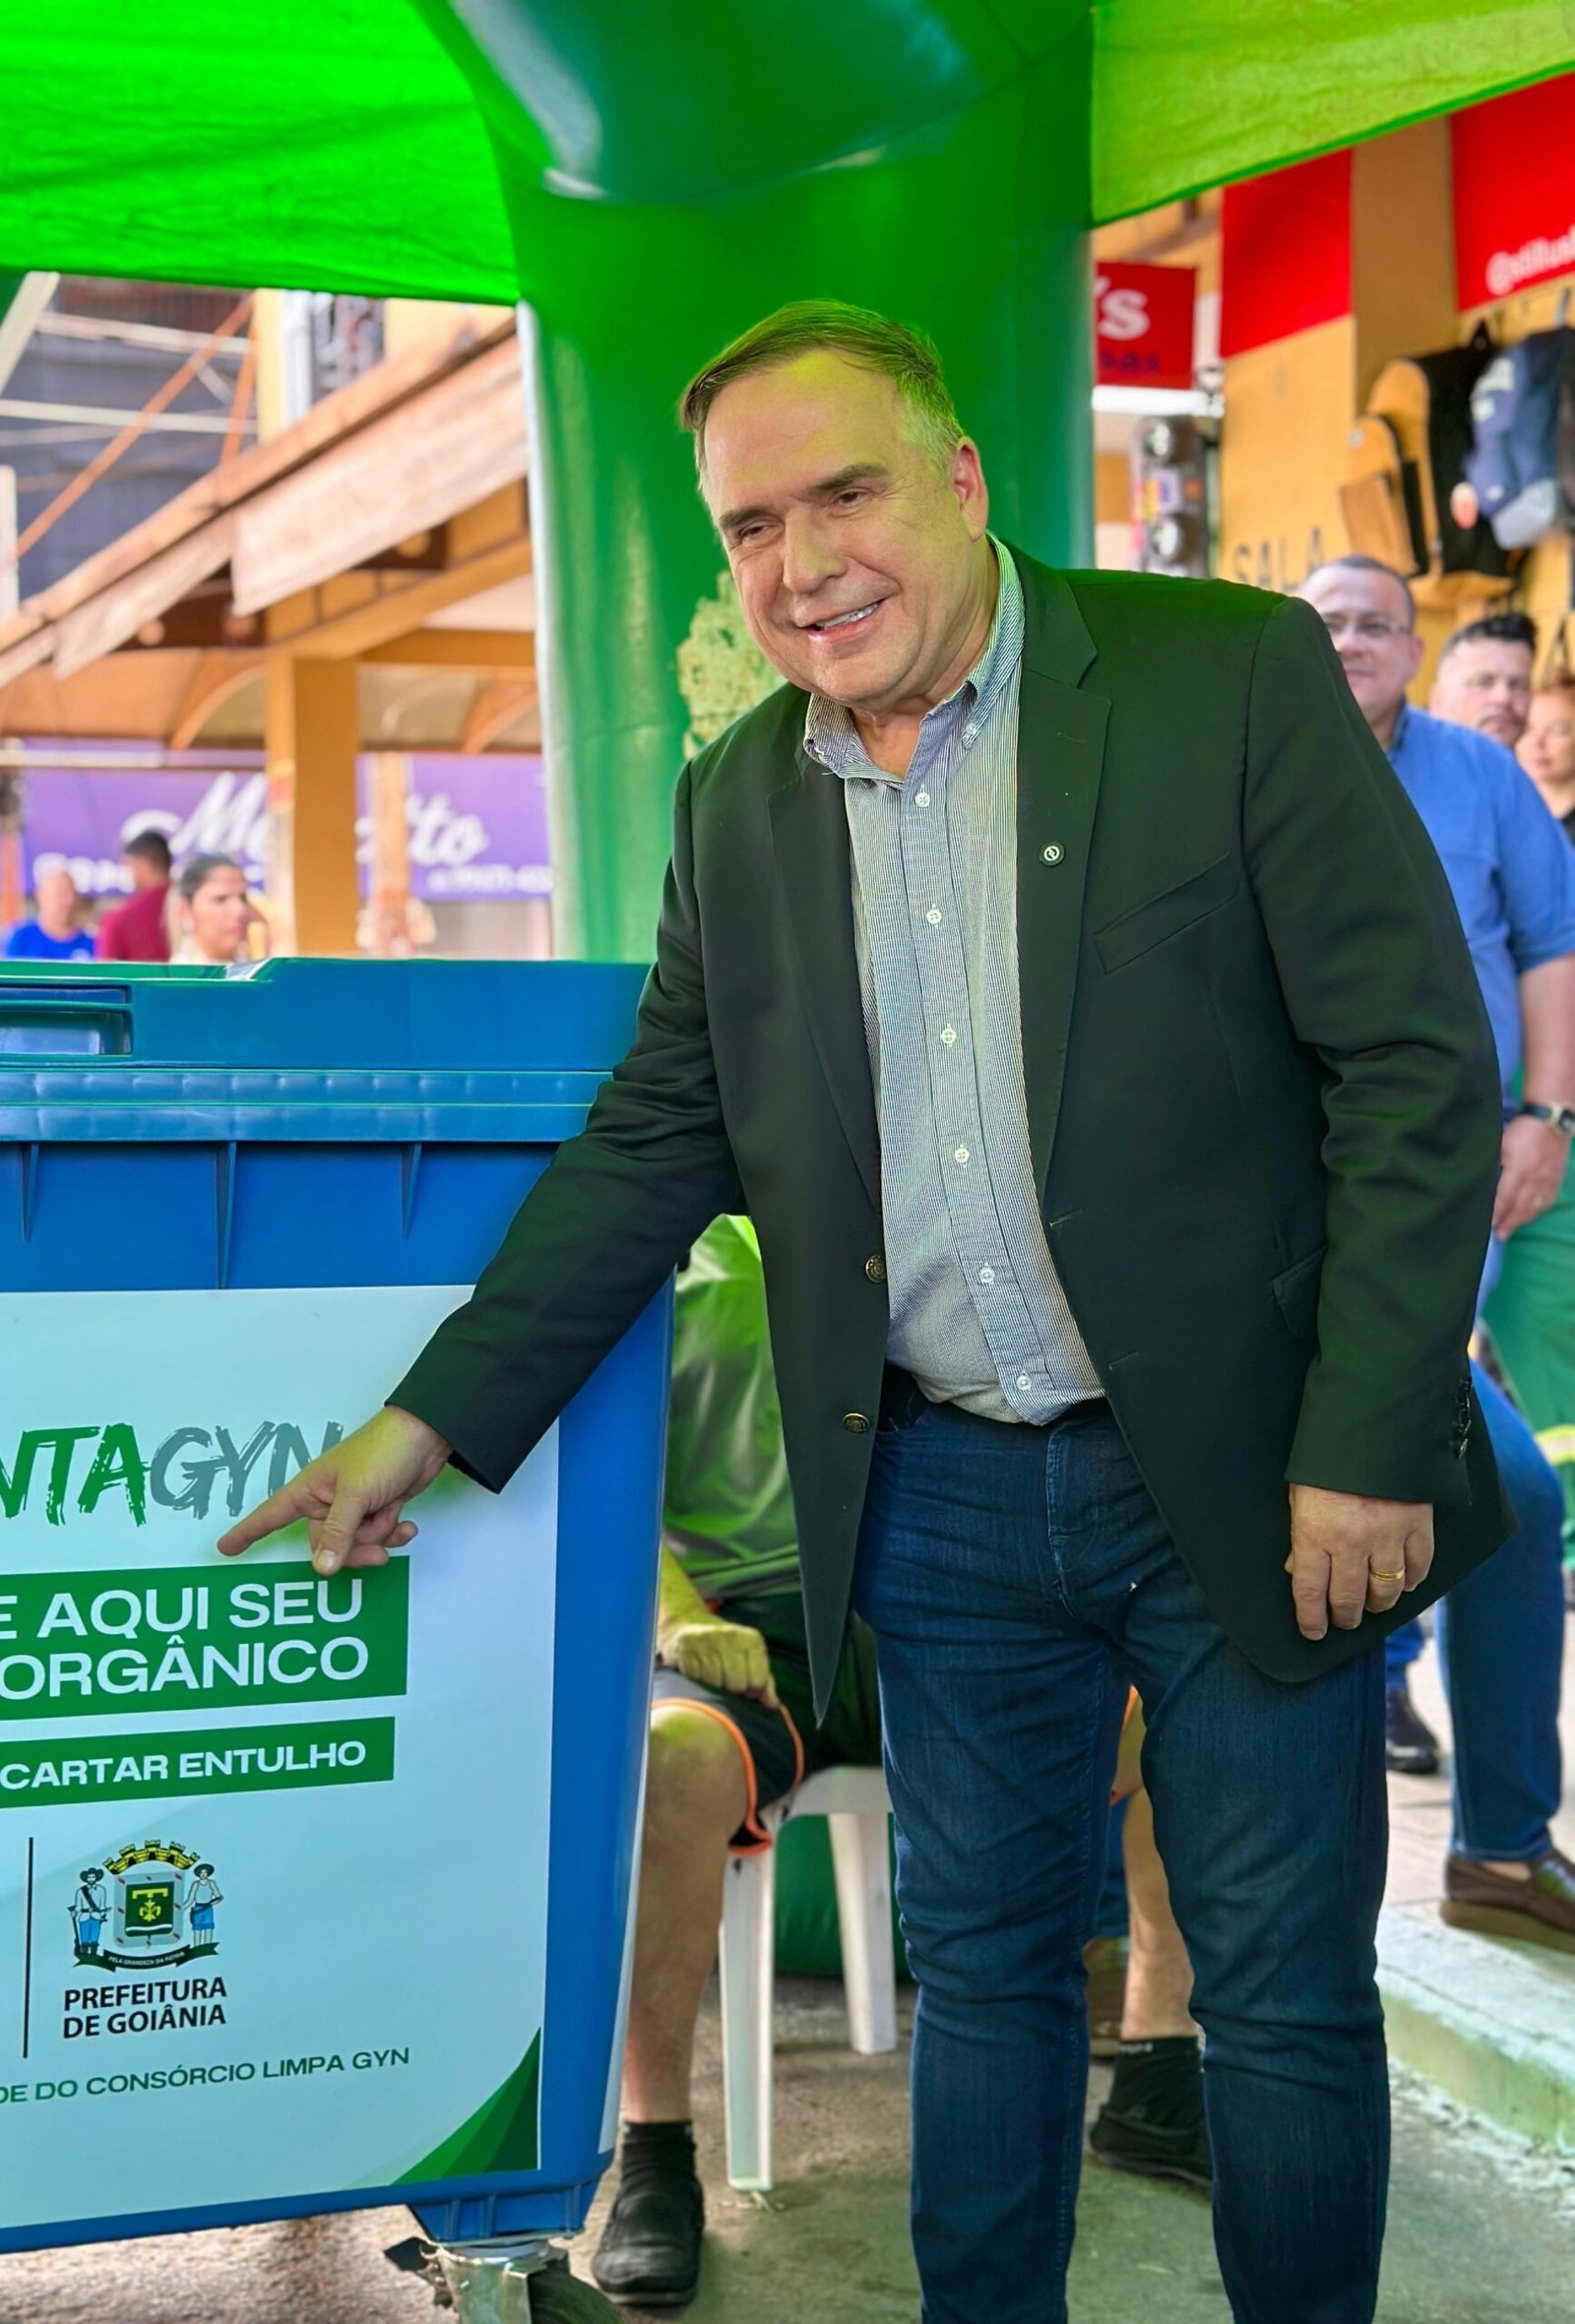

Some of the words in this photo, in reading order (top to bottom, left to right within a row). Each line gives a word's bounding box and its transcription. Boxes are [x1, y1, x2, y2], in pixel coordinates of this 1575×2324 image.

[36, 1586, 210, 1640] AQUI
[228, 1578, 363, 1628] SEU
[0, 1634, 369, 1701] ORGÂNICO
[0, 1754, 168, 1790] CARTAR
[178, 1739, 366, 1779] ENTULHO
[64, 1977, 227, 2011] PREFEITURA
[63, 2015, 100, 2040] DE
[106, 2003, 226, 2035] GOIÂNIA
[35, 2080, 79, 2101] DO
[86, 2063, 256, 2096] CONSÓRCIO
[262, 2054, 345, 2079] LIMPA
[352, 2046, 410, 2070] GYN
